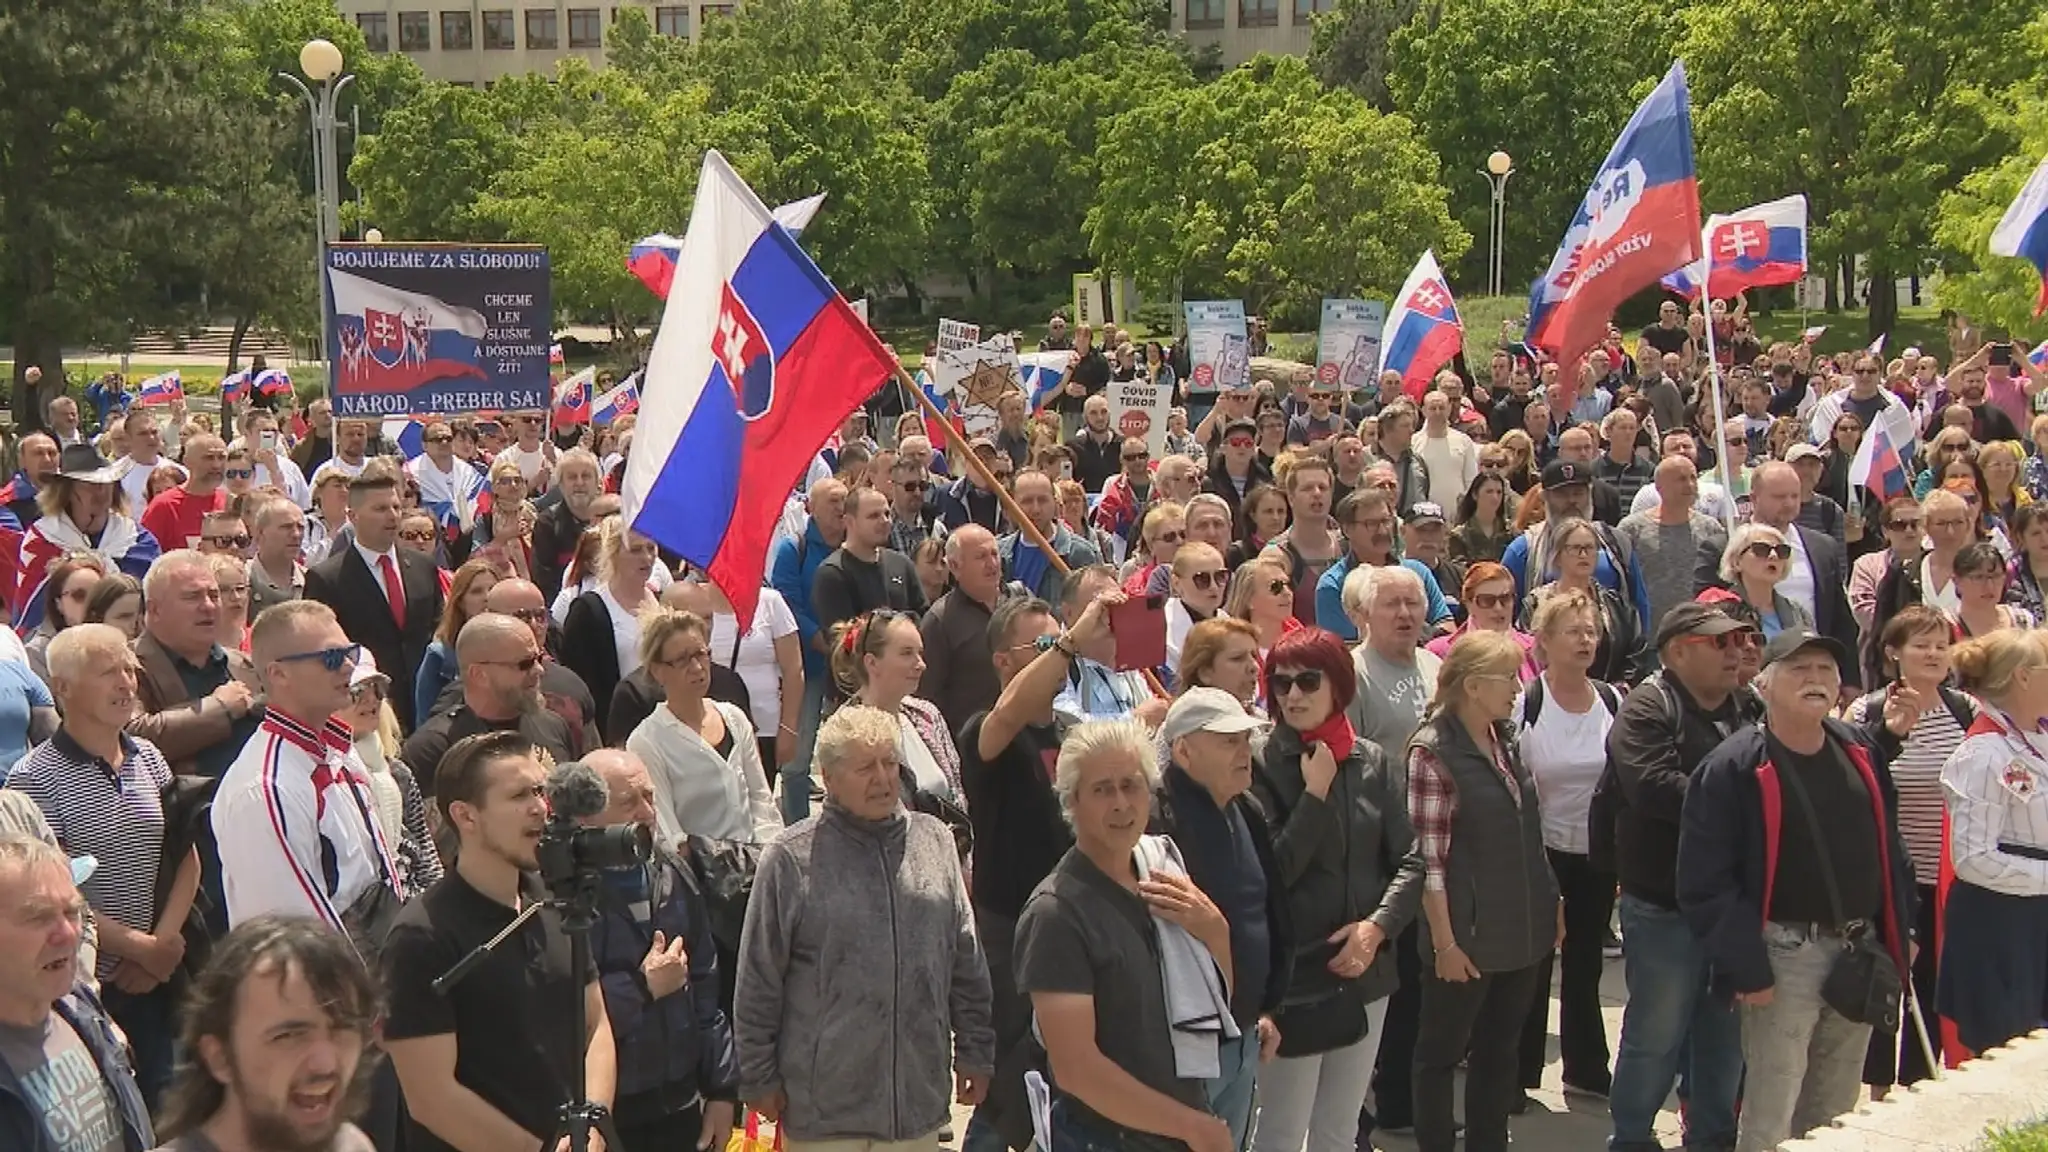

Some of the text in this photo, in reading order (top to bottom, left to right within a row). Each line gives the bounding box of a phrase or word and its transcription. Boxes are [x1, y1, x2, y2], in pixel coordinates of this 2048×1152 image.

[333, 252, 541, 268] BOJUJEME ZA SLOBODU!
[484, 294, 533, 306] CHCEME
[497, 311, 520, 323] LEN
[487, 326, 531, 340] SLUŠNE
[473, 345, 482, 357] A
[1122, 386, 1157, 396] COVID
[341, 392, 415, 415] NÁROD,
[431, 393, 505, 411] PREBER
[510, 391, 541, 407] SA!
[1119, 397, 1156, 407] TEROR
[1120, 419, 1150, 430] STOP
